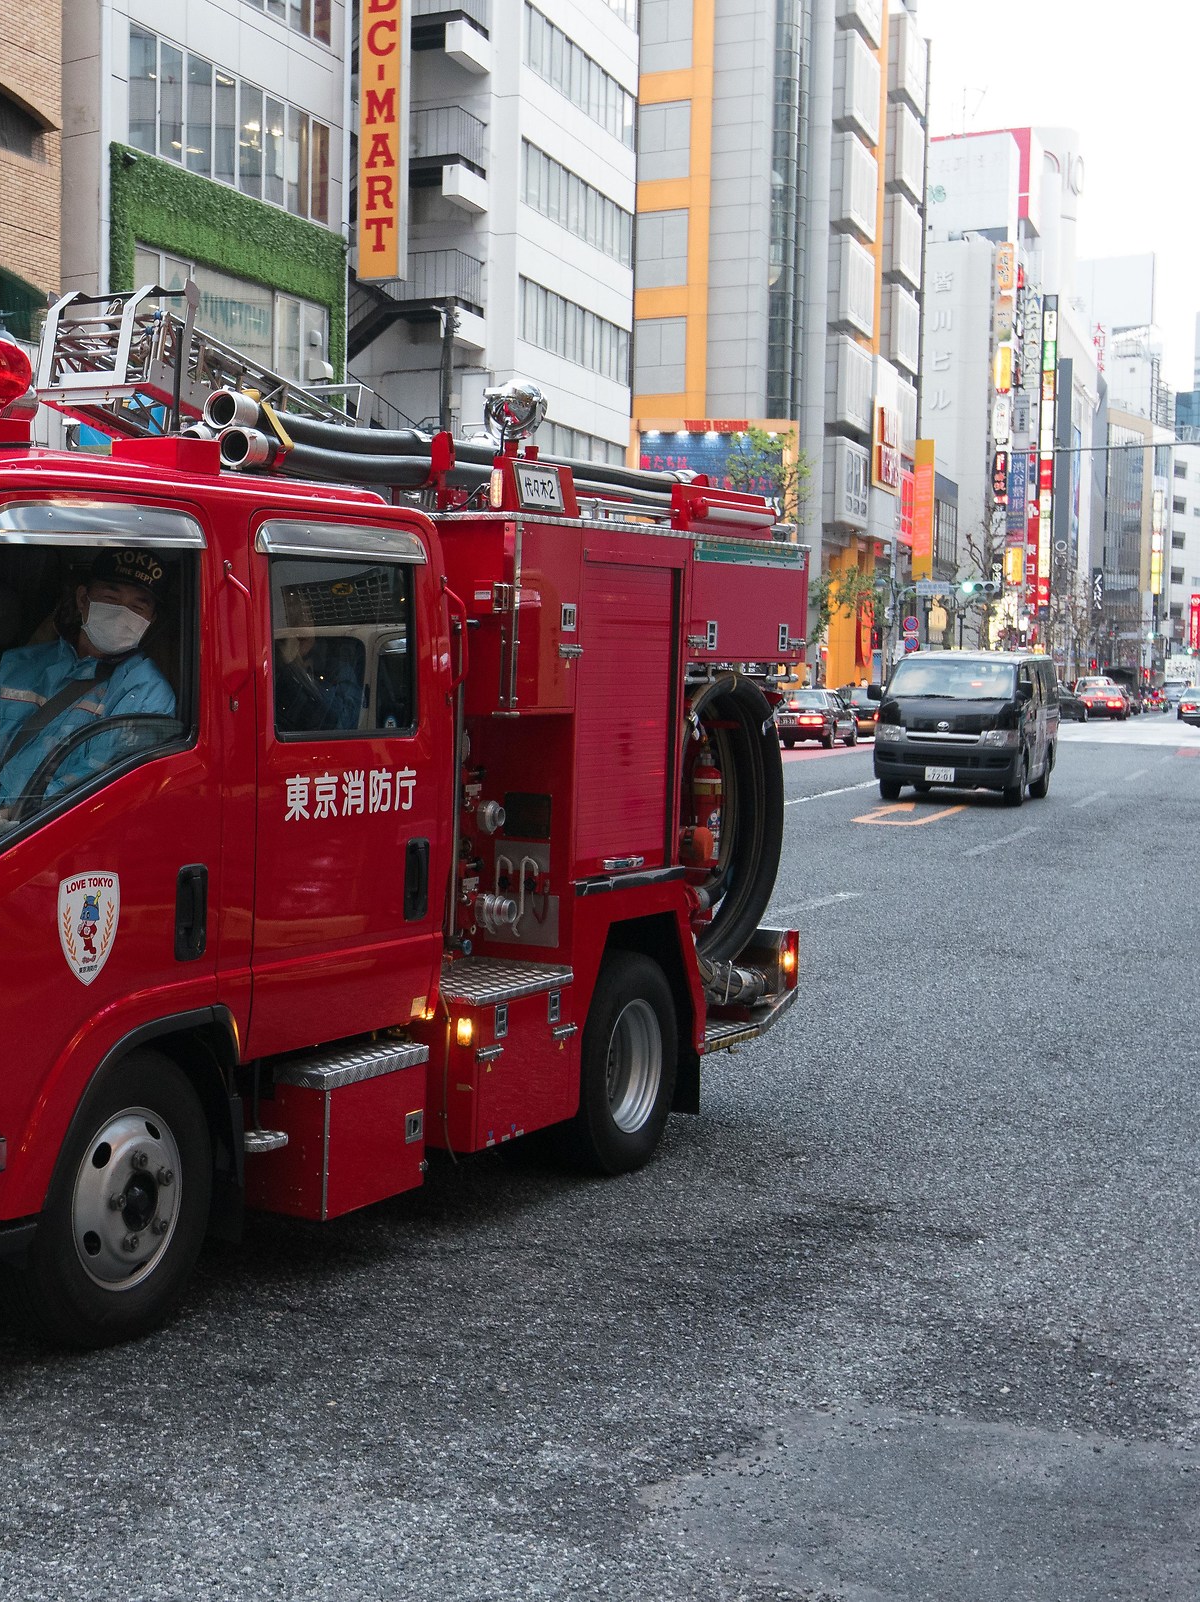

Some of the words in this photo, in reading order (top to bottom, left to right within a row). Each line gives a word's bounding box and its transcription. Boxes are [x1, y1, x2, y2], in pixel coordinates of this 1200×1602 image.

[929, 270, 954, 411] 皆川ビル
[524, 476, 555, 500] 代々木2
[1012, 461, 1025, 509] 渋谷整形
[112, 550, 163, 580] TOKYO
[115, 565, 133, 576] FIRE
[134, 570, 154, 584] DEPT
[285, 766, 417, 822] 東京消防庁
[66, 879, 86, 894] LOVE
[88, 877, 113, 889] TOKYO
